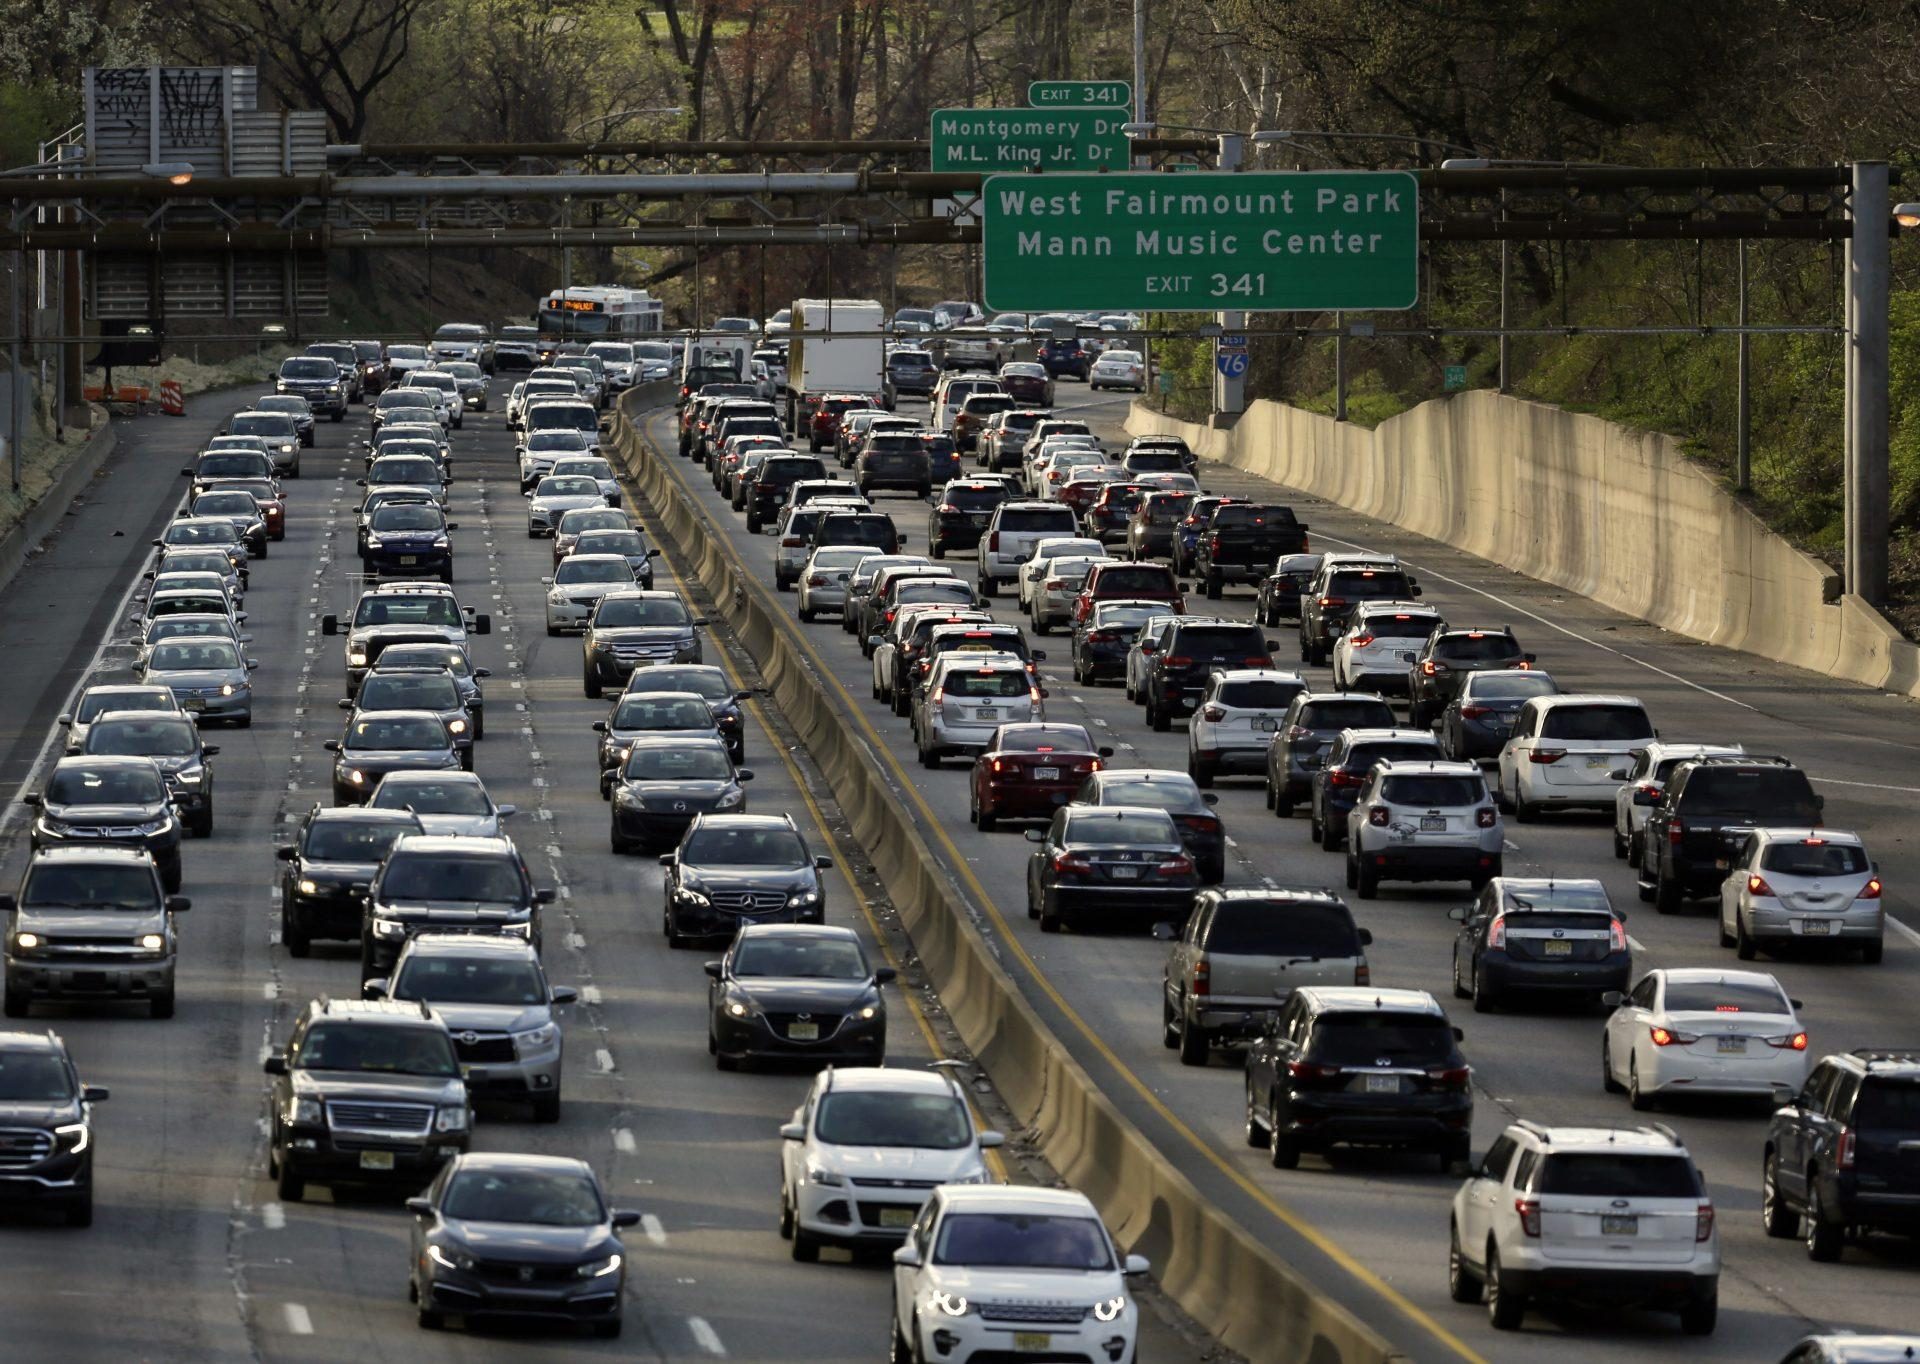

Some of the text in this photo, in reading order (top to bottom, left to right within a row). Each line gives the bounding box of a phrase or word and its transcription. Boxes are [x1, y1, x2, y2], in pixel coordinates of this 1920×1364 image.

[1041, 87, 1118, 102] EXIT 341
[941, 119, 1120, 140] Montgomery Dr
[947, 144, 1113, 164] M.L. King Jr. Dr
[1000, 188, 1401, 215] West Fairmount Park
[1018, 229, 1382, 256] Mann Music Center
[1146, 273, 1265, 296] EXIT 341
[1220, 354, 1245, 373] 76
